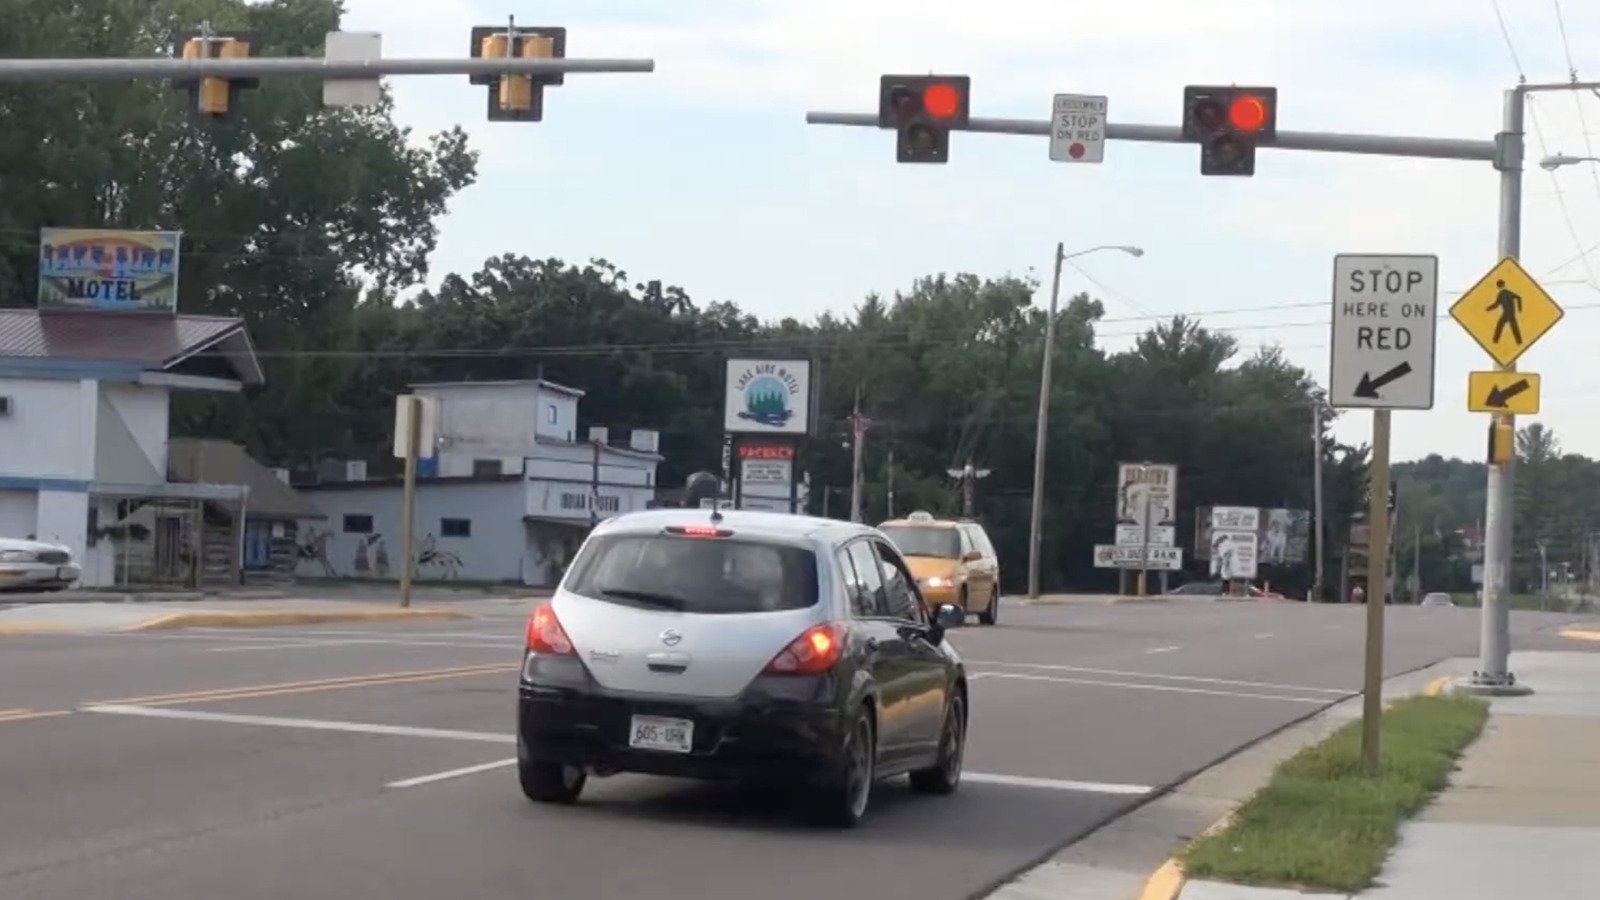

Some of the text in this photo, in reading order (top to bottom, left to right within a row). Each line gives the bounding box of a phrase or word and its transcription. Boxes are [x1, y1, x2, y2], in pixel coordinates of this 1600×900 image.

[1061, 114, 1098, 128] STOP
[1057, 129, 1100, 142] ON RED
[67, 279, 141, 301] MOTEL
[1350, 270, 1423, 293] STOP
[1343, 302, 1426, 318] HERE ON
[1357, 327, 1411, 350] RED
[778, 368, 800, 395] MOTEL
